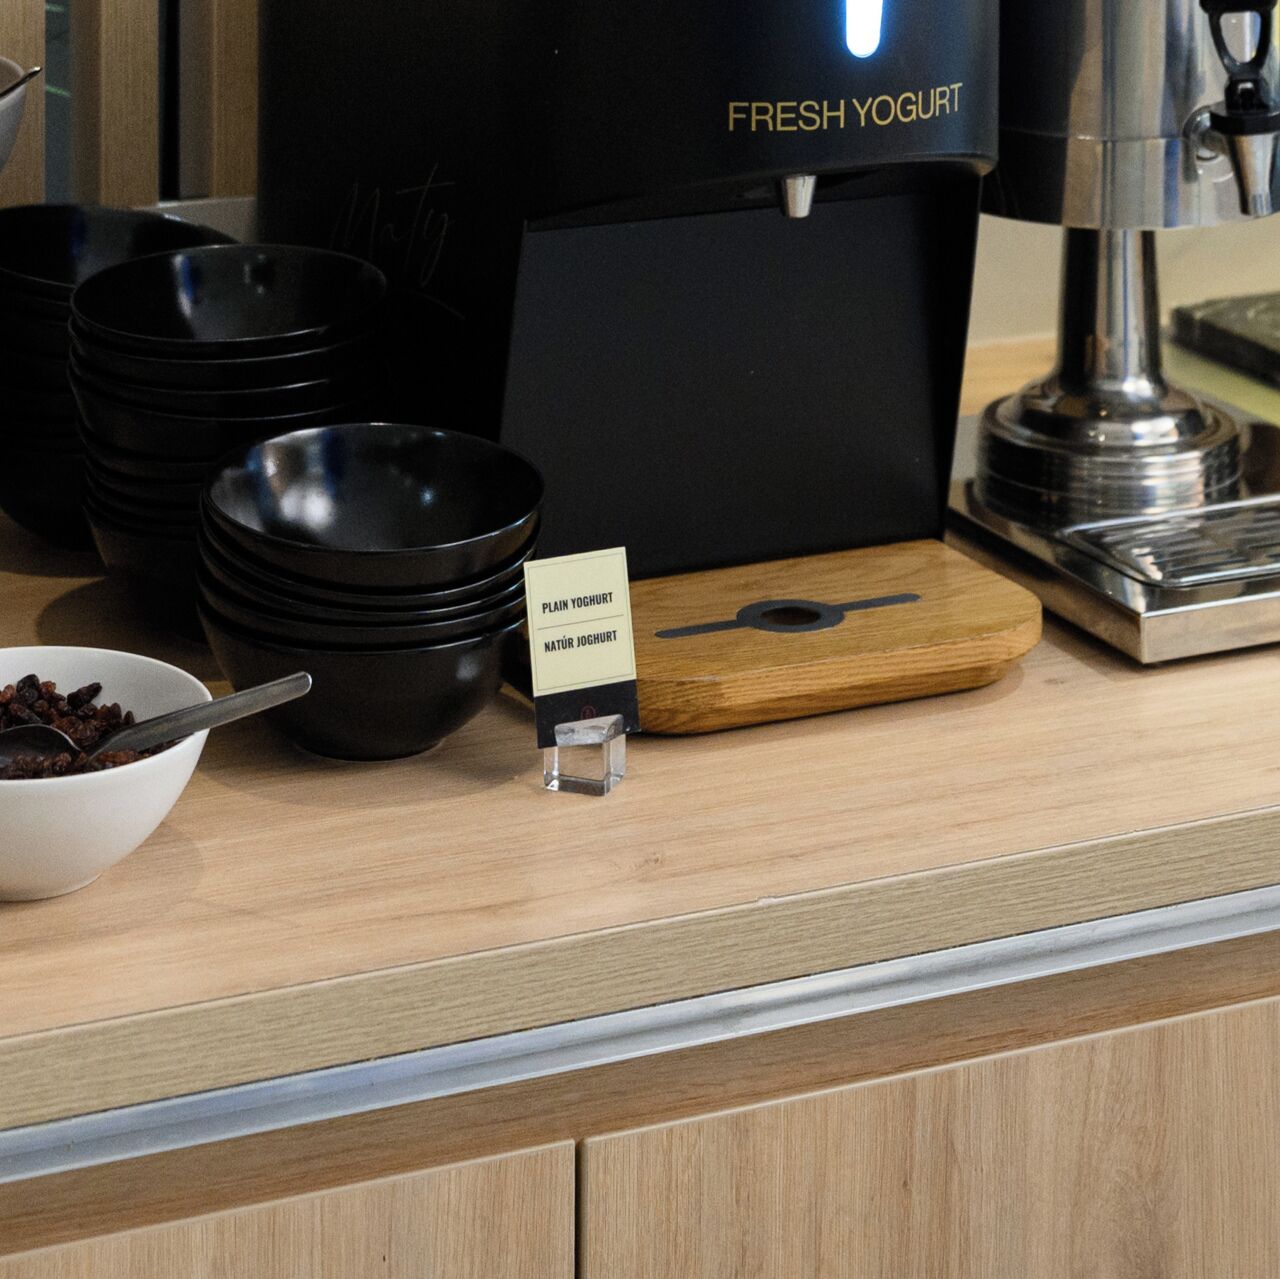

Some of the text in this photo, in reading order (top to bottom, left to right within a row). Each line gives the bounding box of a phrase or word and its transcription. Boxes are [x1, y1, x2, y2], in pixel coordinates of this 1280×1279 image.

[728, 82, 964, 132] FRESH YOGURT
[542, 592, 613, 614] PLAIN YOGHURT
[544, 630, 617, 653] NATÚR JOGHURT
